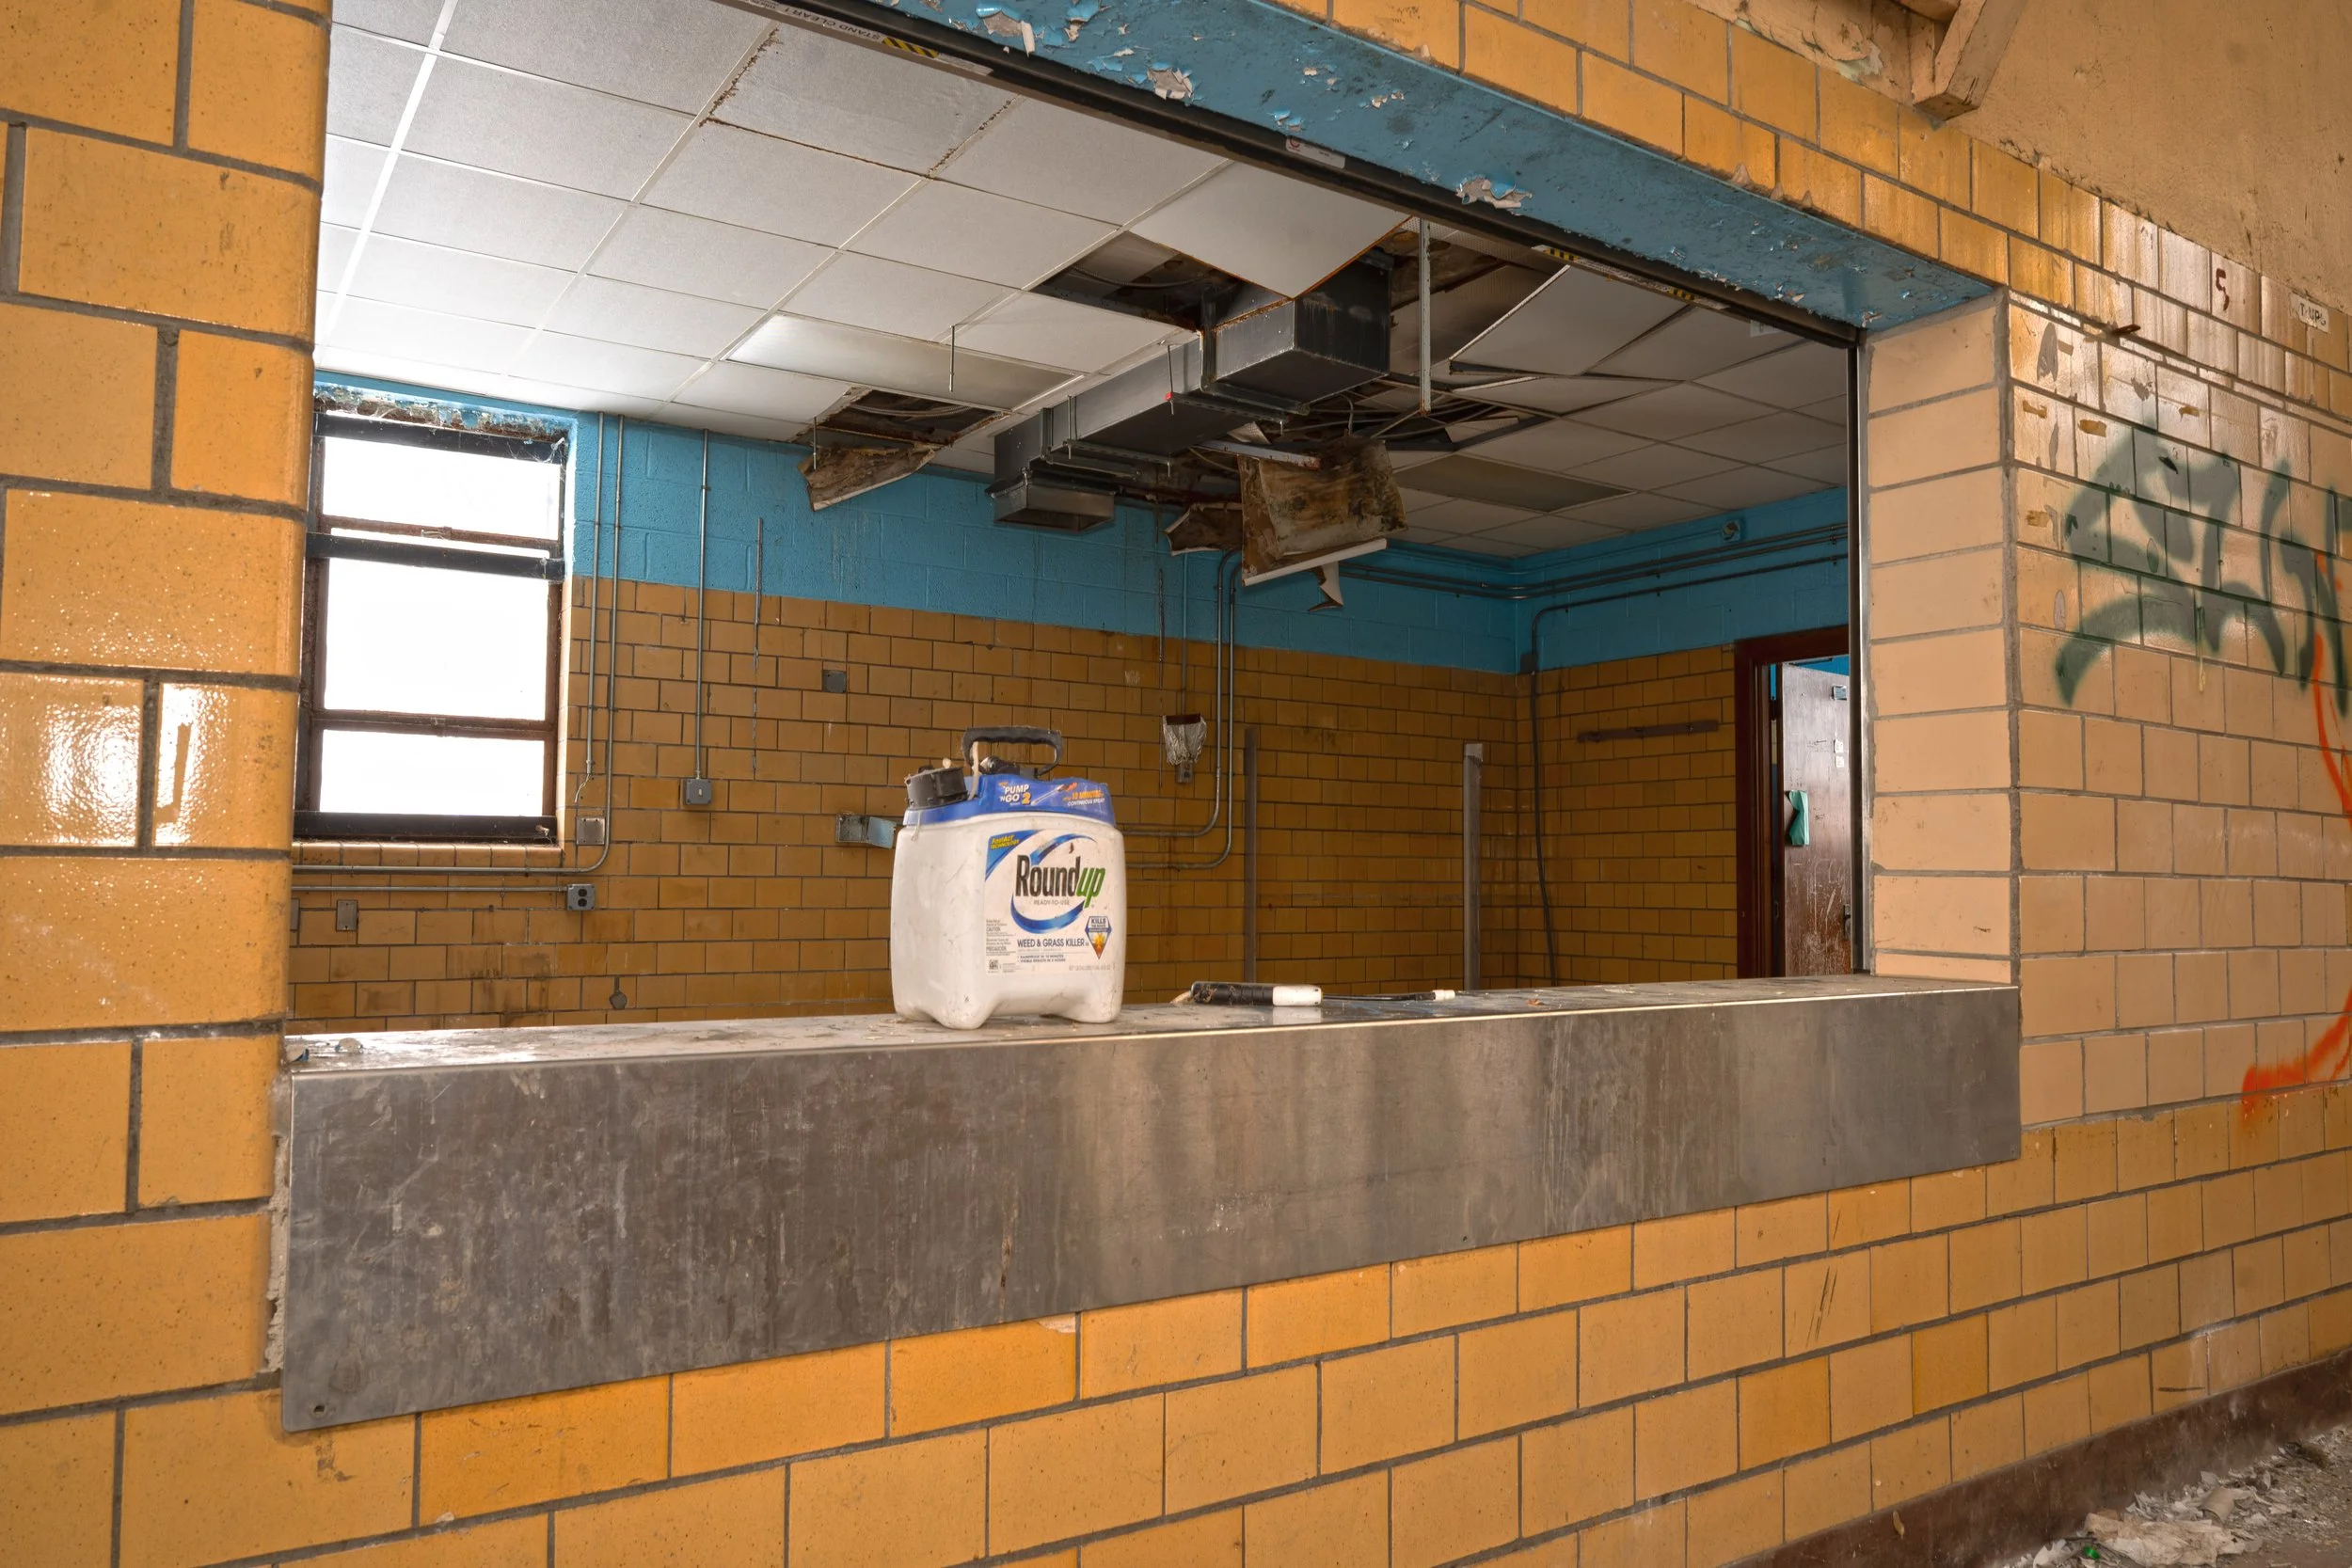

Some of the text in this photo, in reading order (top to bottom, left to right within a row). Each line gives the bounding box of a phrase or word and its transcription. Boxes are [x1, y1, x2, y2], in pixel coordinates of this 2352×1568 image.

[792, 10, 836, 27] CLEAR
[839, 24, 882, 40] STAND
[1004, 784, 1030, 794] PUMP
[1021, 792, 1032, 805] 2
[1014, 854, 1106, 909] Roundup
[1017, 939, 1036, 947] WEED
[1036, 939, 1041, 947] &
[1042, 938, 1064, 947] GRASS
[1065, 937, 1085, 946] KILLER
